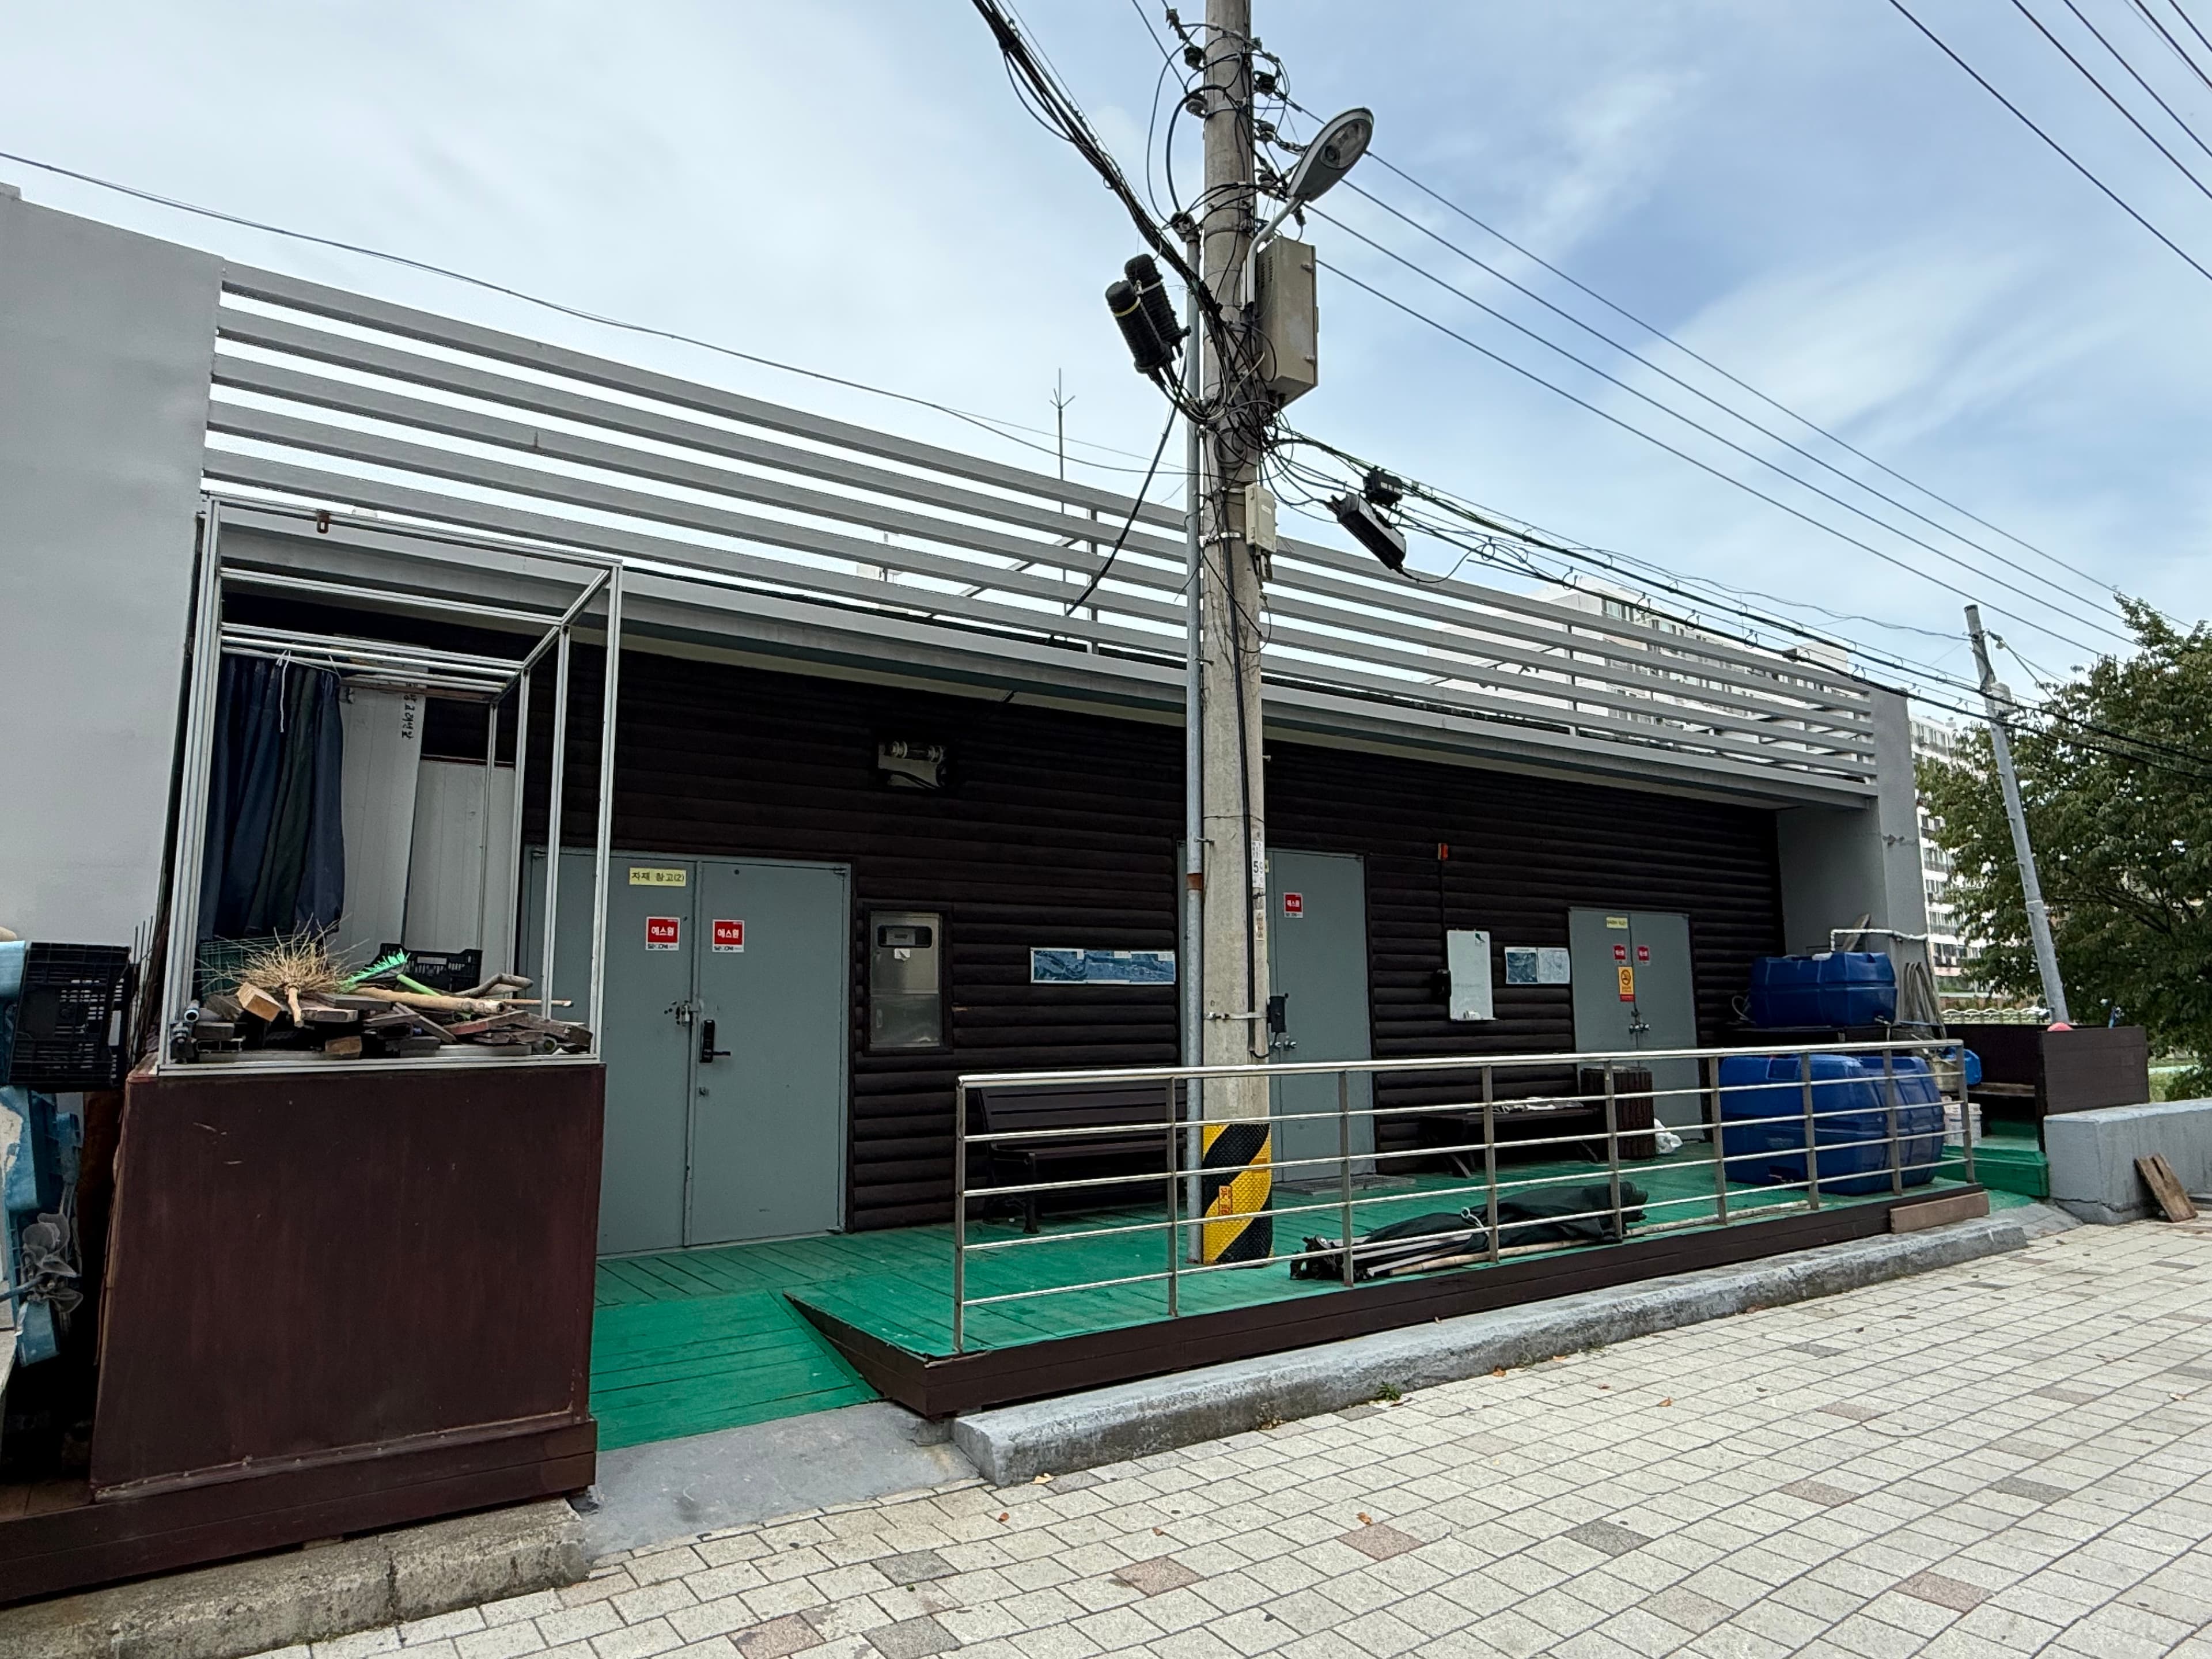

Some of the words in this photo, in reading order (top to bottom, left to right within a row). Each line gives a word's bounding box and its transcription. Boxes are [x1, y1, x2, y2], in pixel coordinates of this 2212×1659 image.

[631, 872, 650, 881] 자재
[656, 872, 685, 882] 창고(2)
[651, 926, 675, 937] 에스원
[717, 929, 739, 938] 에스원
